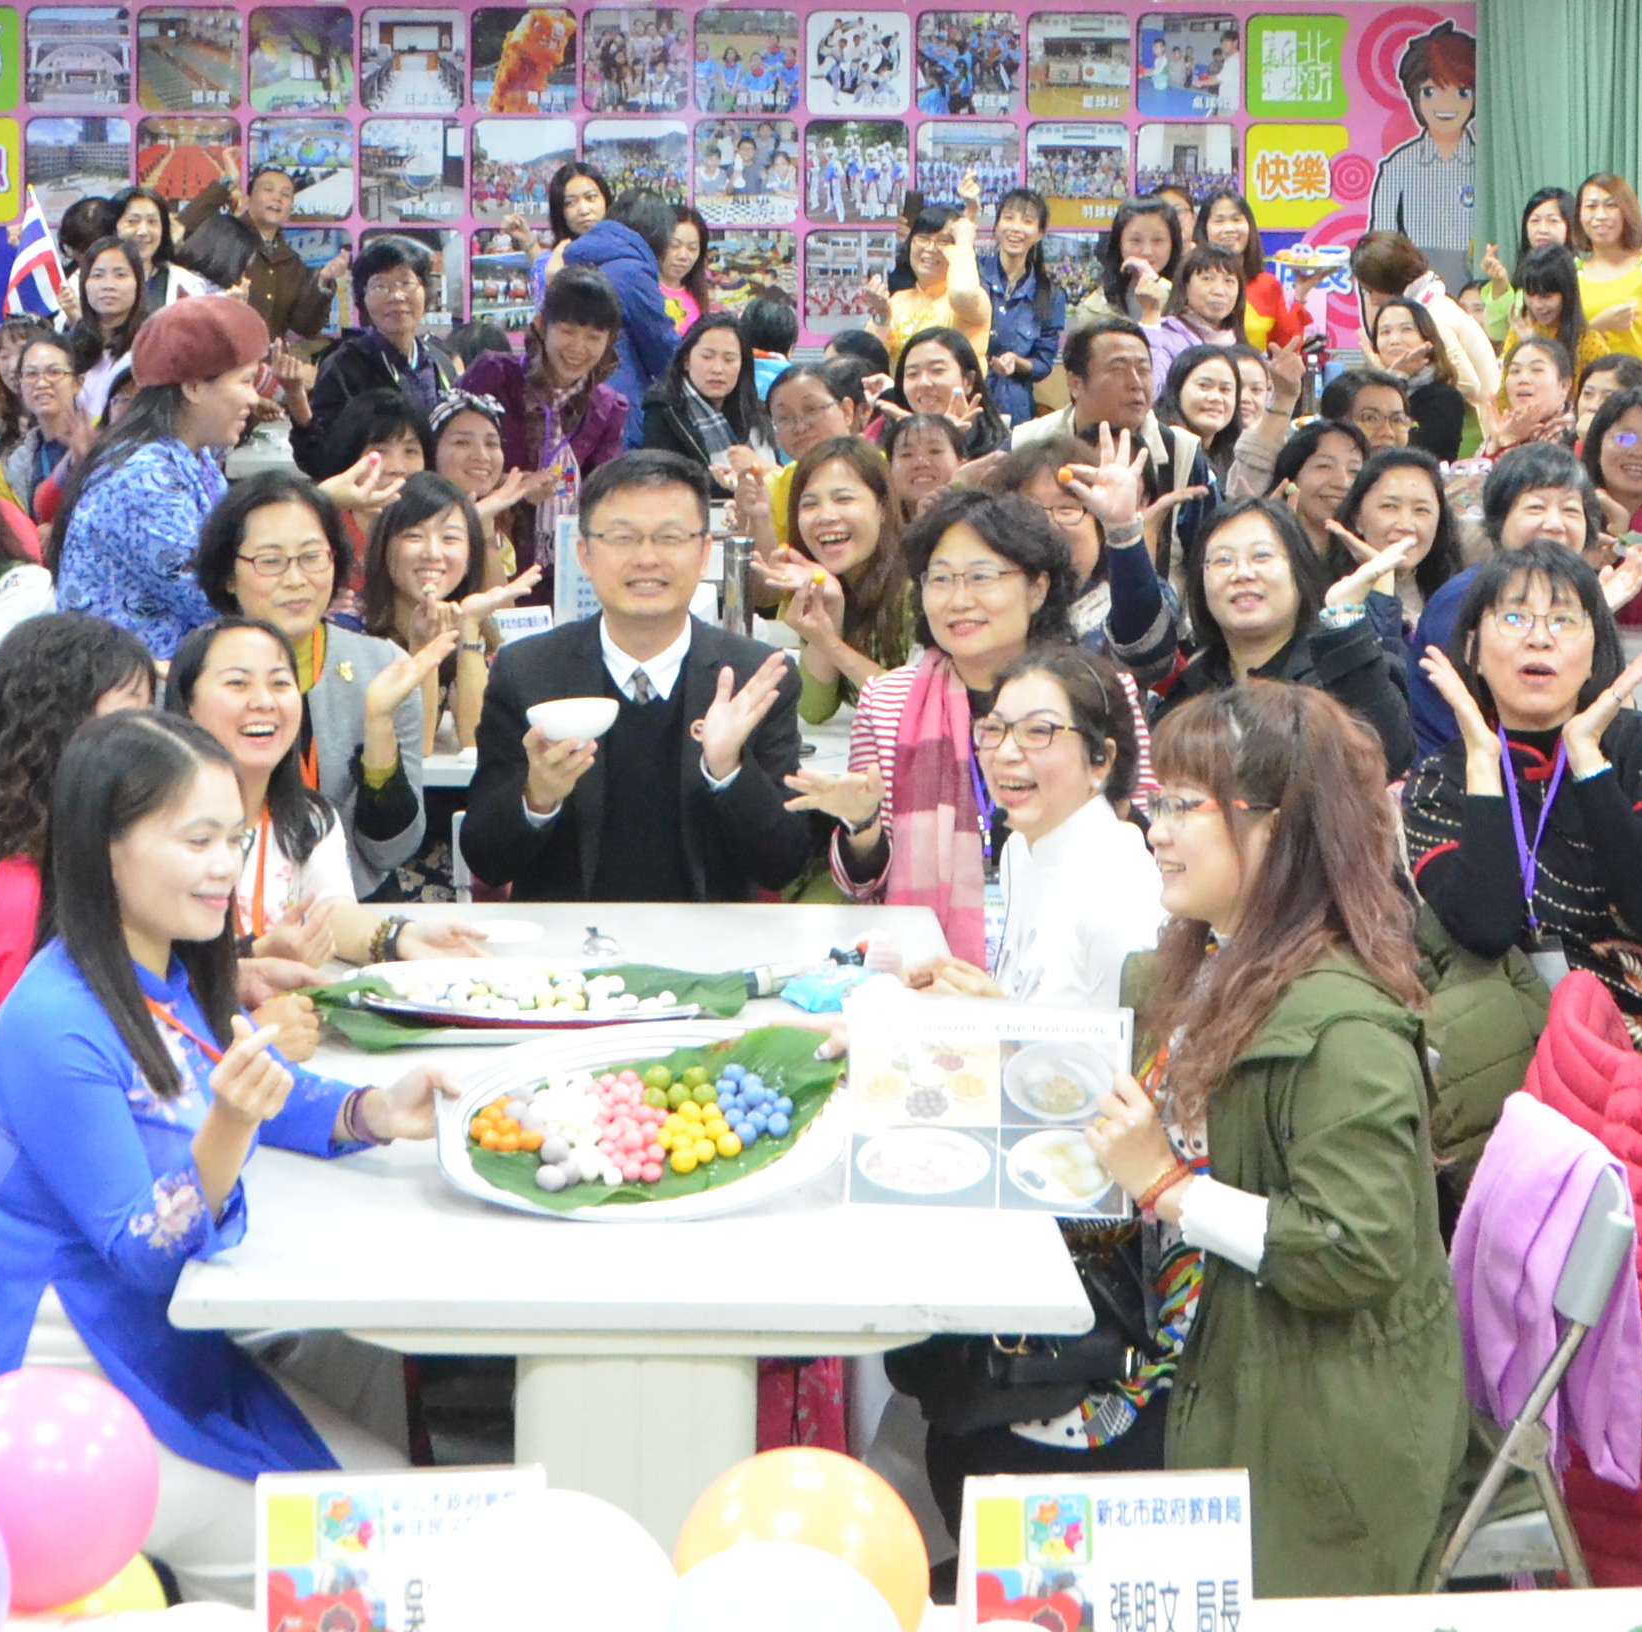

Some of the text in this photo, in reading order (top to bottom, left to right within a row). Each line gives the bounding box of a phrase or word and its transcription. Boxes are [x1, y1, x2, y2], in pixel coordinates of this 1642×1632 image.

[1255, 152, 1328, 198] 快樂
[1096, 1496, 1242, 1526] 新北市政府教育局
[1110, 1580, 1241, 1632] 張明文 局長
